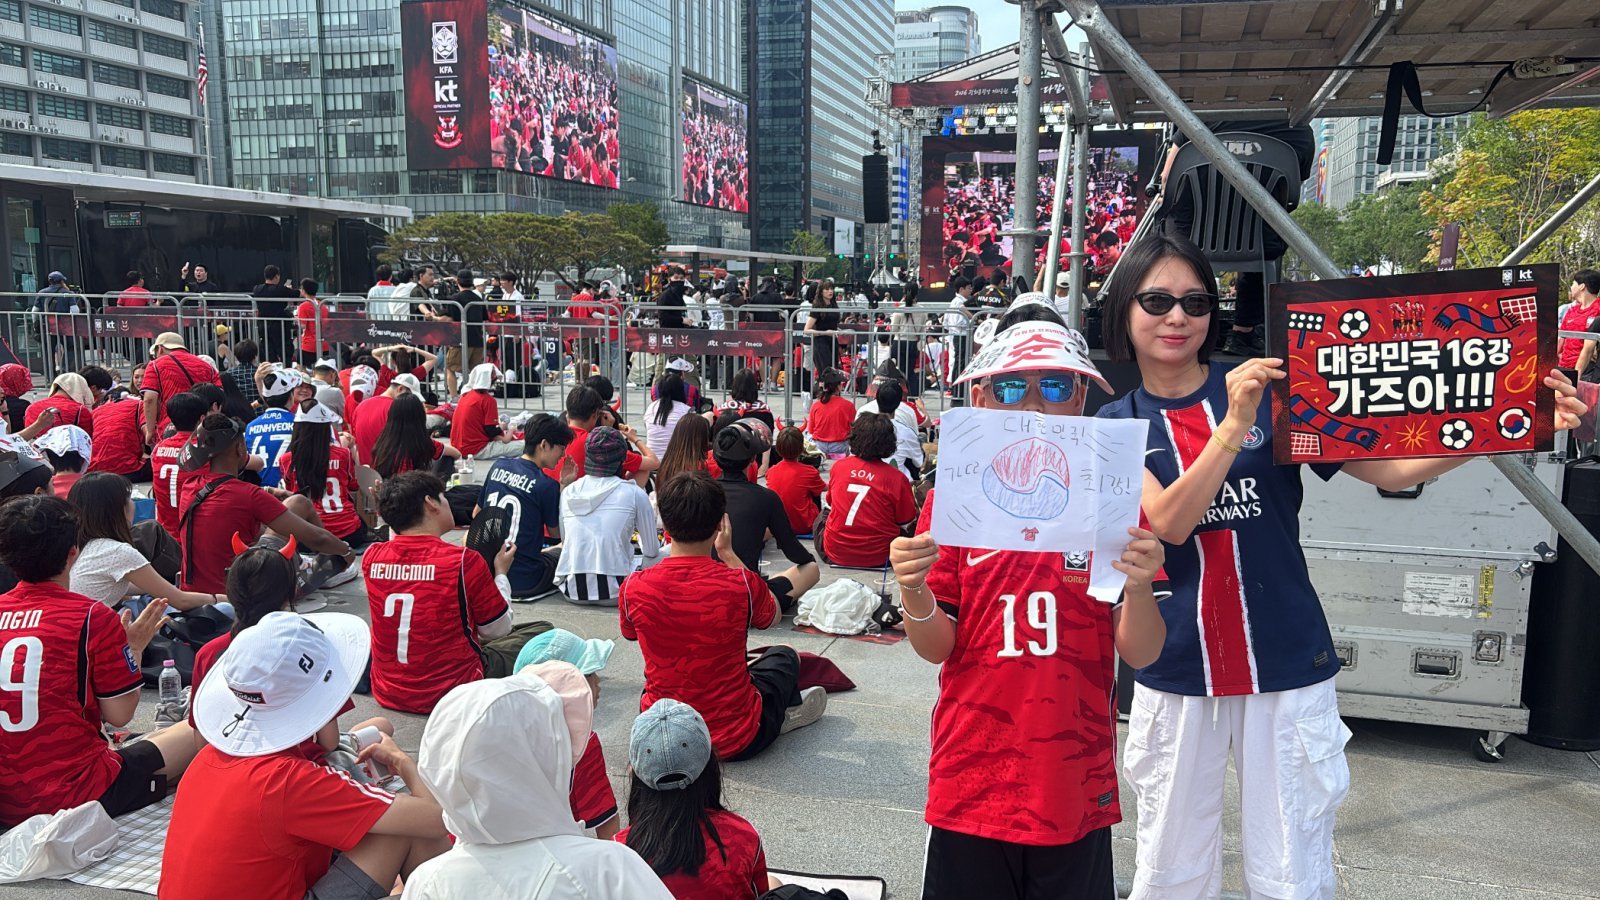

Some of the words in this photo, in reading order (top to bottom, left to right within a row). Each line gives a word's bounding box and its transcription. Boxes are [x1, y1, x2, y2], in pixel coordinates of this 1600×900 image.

[439, 66, 453, 74] KFA
[434, 80, 458, 102] kt
[1519, 269, 1533, 280] kt
[105, 319, 116, 329] kt
[544, 341, 556, 354] 19
[662, 334, 673, 345] kt
[1317, 338, 1441, 376] 대한민국
[1447, 337, 1512, 368] 16강
[1327, 371, 1495, 415] 가즈아!!!
[248, 422, 294, 435] MINHYEOK
[155, 447, 181, 458] HEUNG
[249, 433, 293, 468] 47
[159, 463, 180, 508] 7
[850, 469, 875, 482] SON
[1211, 477, 1260, 507] AR
[845, 483, 872, 527] 7
[1199, 501, 1262, 525] IRWAYS
[369, 562, 436, 581] HEUNGMIN
[1062, 575, 1088, 584] KOREA
[0, 610, 43, 630] NGIN
[383, 592, 415, 665] 7
[996, 591, 1058, 657] 19
[298, 652, 315, 674] FJ
